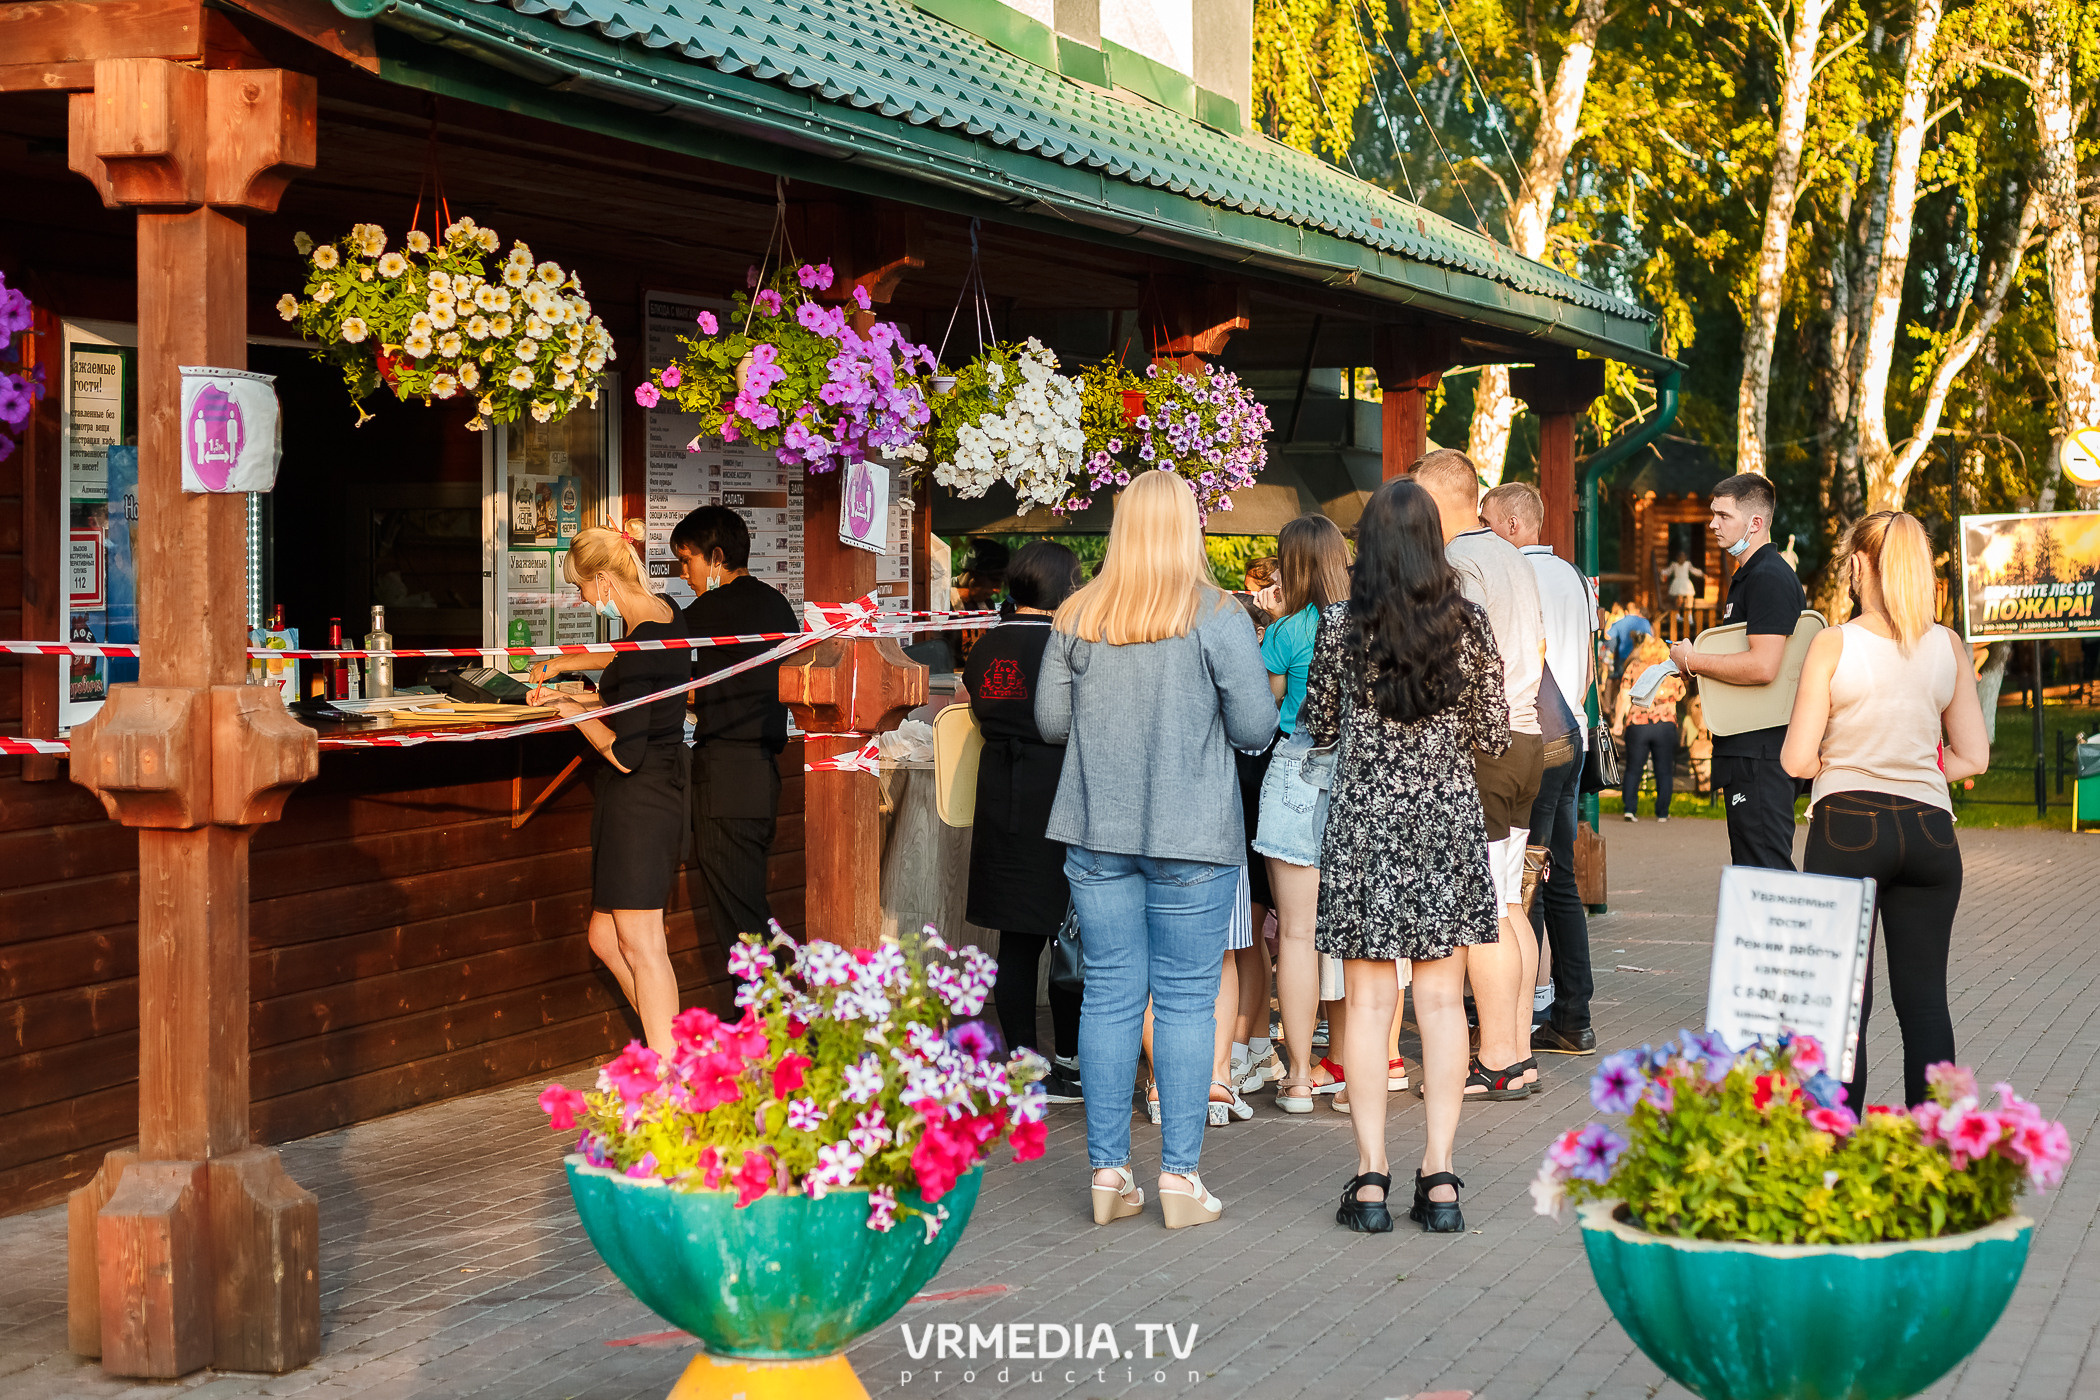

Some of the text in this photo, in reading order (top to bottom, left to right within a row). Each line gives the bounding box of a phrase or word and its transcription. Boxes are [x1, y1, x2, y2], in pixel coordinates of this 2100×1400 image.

[73, 377, 102, 392] гости!
[510, 555, 547, 569] Уважаемые
[650, 563, 670, 575] СОУСЫ
[74, 576, 86, 589] 112
[519, 571, 539, 583] гости!
[2049, 582, 2076, 598] ЛЕС
[2075, 581, 2096, 596] ОТ
[1983, 594, 2095, 621] ПОЖАРА!
[74, 629, 93, 642] АФЕ
[1752, 890, 1837, 909] Уважаемые
[1735, 936, 1841, 960] Режим работы
